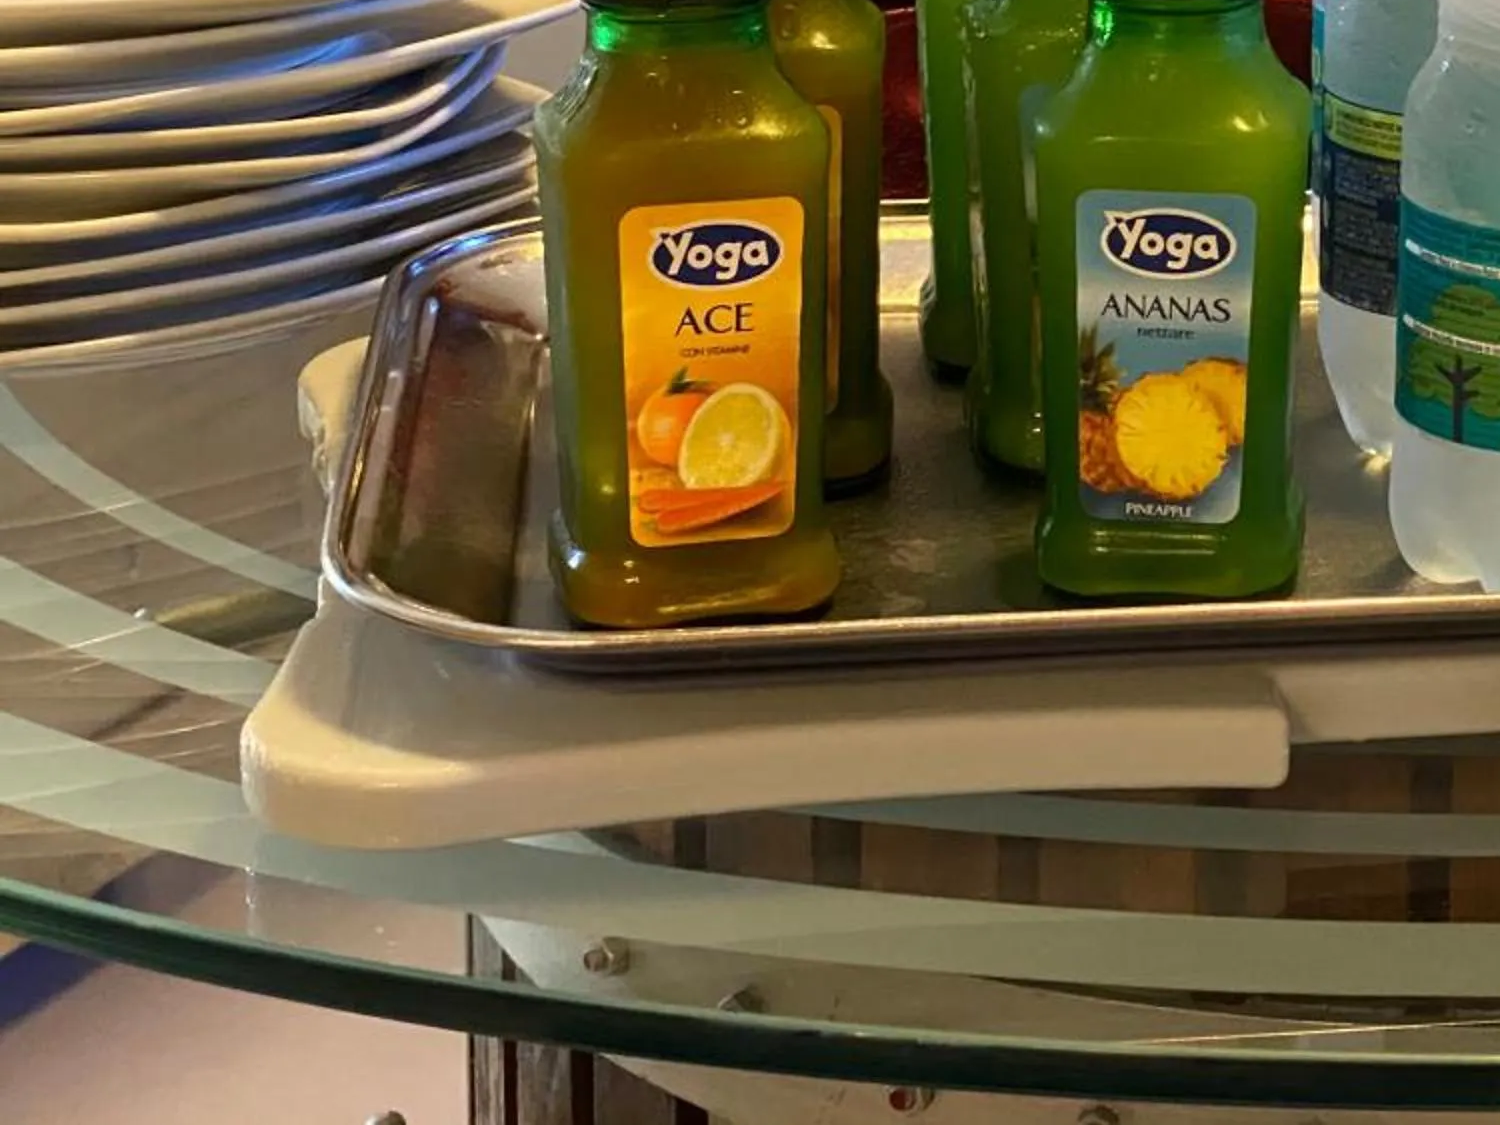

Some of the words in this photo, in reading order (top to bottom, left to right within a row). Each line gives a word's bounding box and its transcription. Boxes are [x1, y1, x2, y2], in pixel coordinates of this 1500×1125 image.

[661, 231, 770, 281] Yoga
[1117, 218, 1220, 271] Yoga
[673, 302, 755, 338] ACE
[1100, 292, 1232, 324] ANANAS
[1125, 502, 1192, 518] PINEAPPLE
